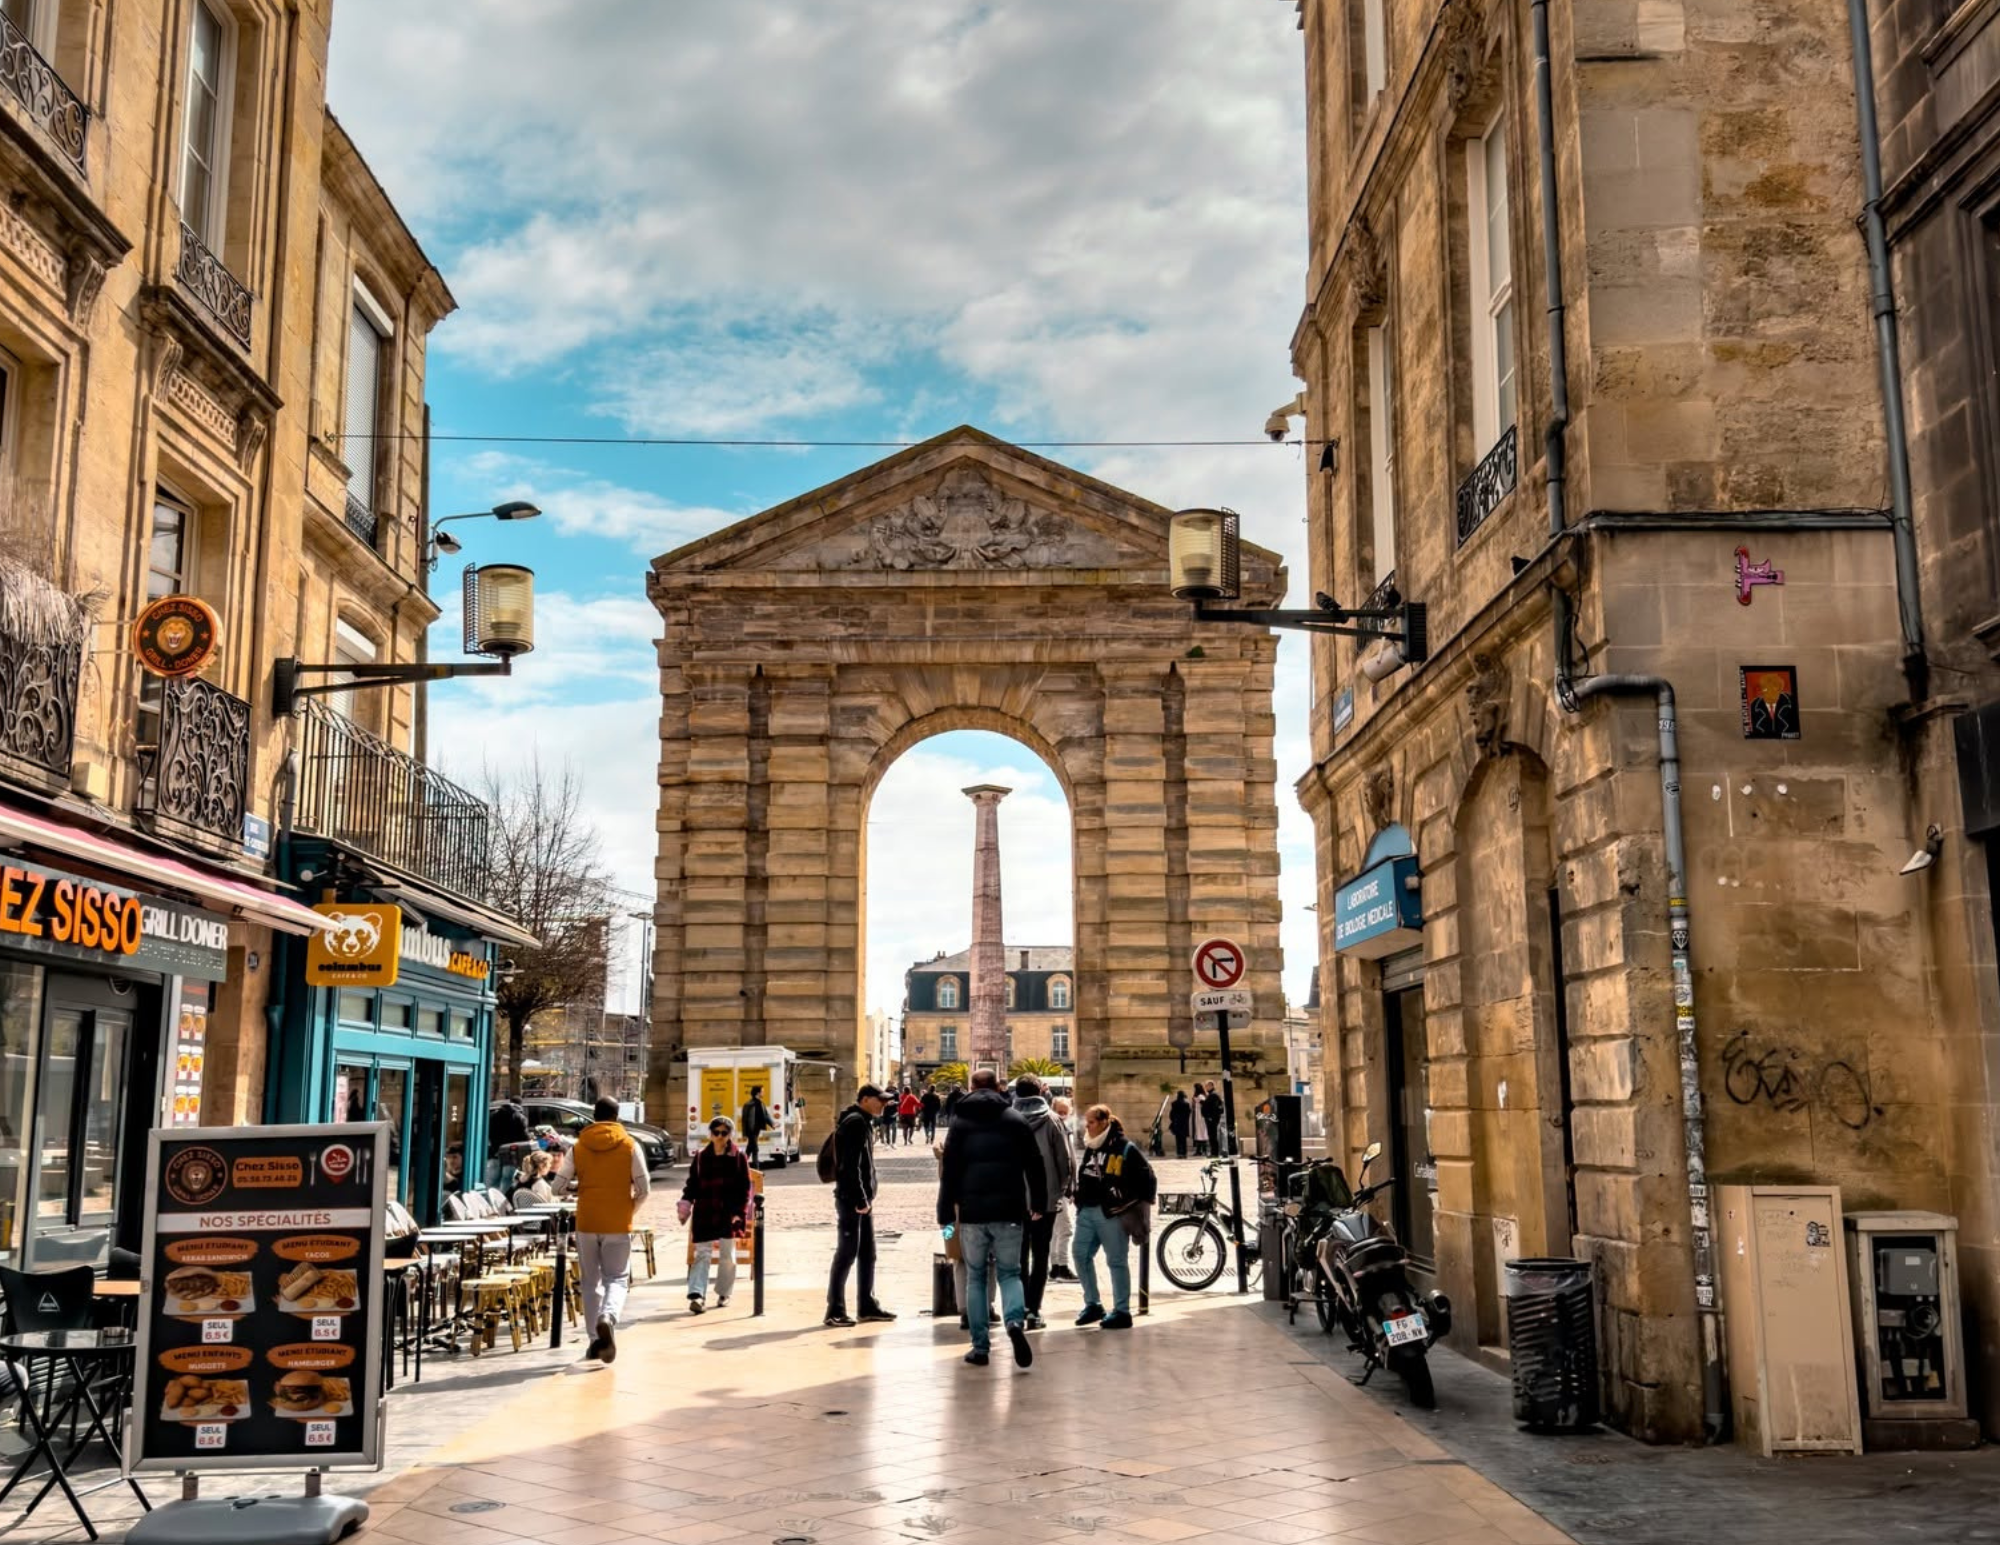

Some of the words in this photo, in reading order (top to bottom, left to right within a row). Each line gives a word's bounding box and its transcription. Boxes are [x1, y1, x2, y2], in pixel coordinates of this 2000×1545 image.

[152, 603, 177, 619] CHEZ
[180, 603, 203, 622] SISSO
[146, 648, 166, 668] GRILL
[175, 646, 203, 668] DONER
[0, 865, 46, 936] EZ
[51, 878, 142, 955] SISSO
[141, 905, 178, 940] GRILL
[180, 915, 228, 950] DONER
[318, 962, 382, 972] columbus
[1200, 996, 1225, 1006] SAUF
[236, 1162, 265, 1171] Chez
[268, 1161, 299, 1170] Sisso
[200, 1216, 233, 1227] NOS
[238, 1213, 331, 1226] SPÉCIALITÉS
[177, 1243, 203, 1252] MENU
[281, 1241, 307, 1250] MENU
[207, 1321, 229, 1329] SEUL
[278, 1348, 303, 1357] MENU
[188, 1362, 226, 1370] NUGGETS
[287, 1359, 336, 1368] HAMBURGER
[201, 1426, 222, 1434] SEUL
